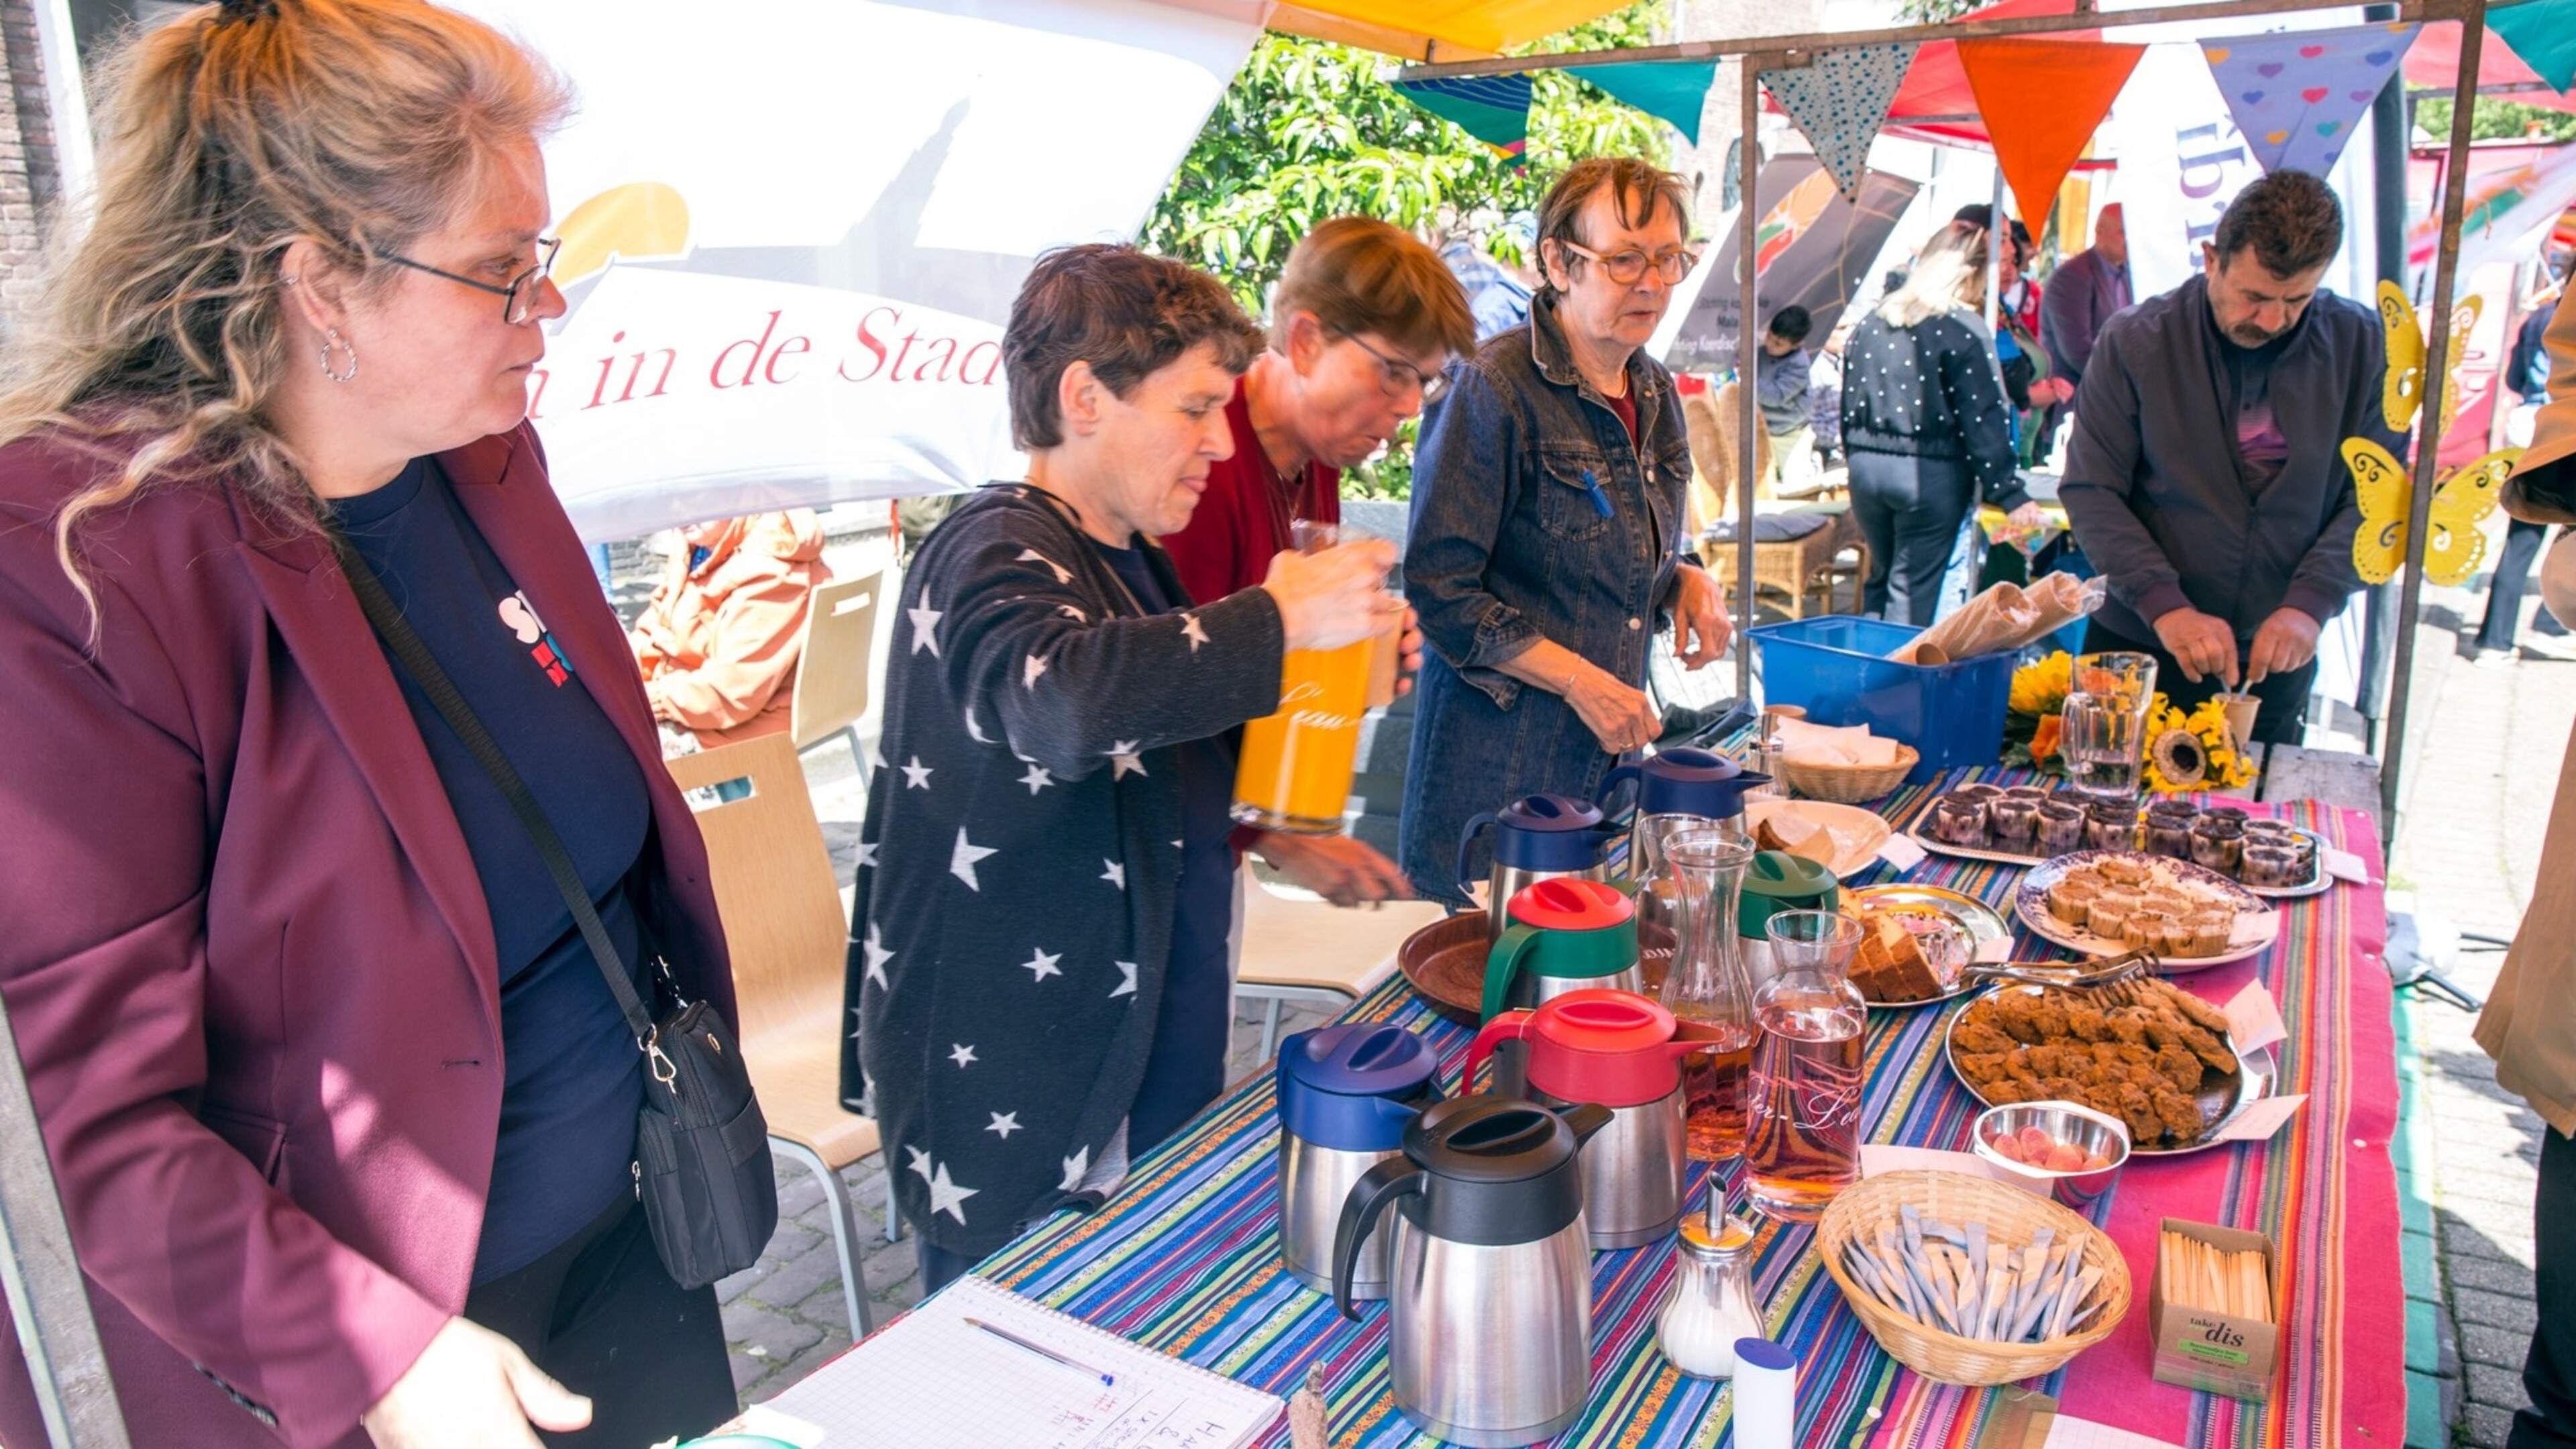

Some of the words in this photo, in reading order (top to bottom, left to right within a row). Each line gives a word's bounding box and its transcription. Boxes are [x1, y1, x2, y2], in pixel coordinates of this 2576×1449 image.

[580, 331, 677, 411] in
[709, 309, 812, 390] de
[2205, 1322, 2245, 1347] dis
